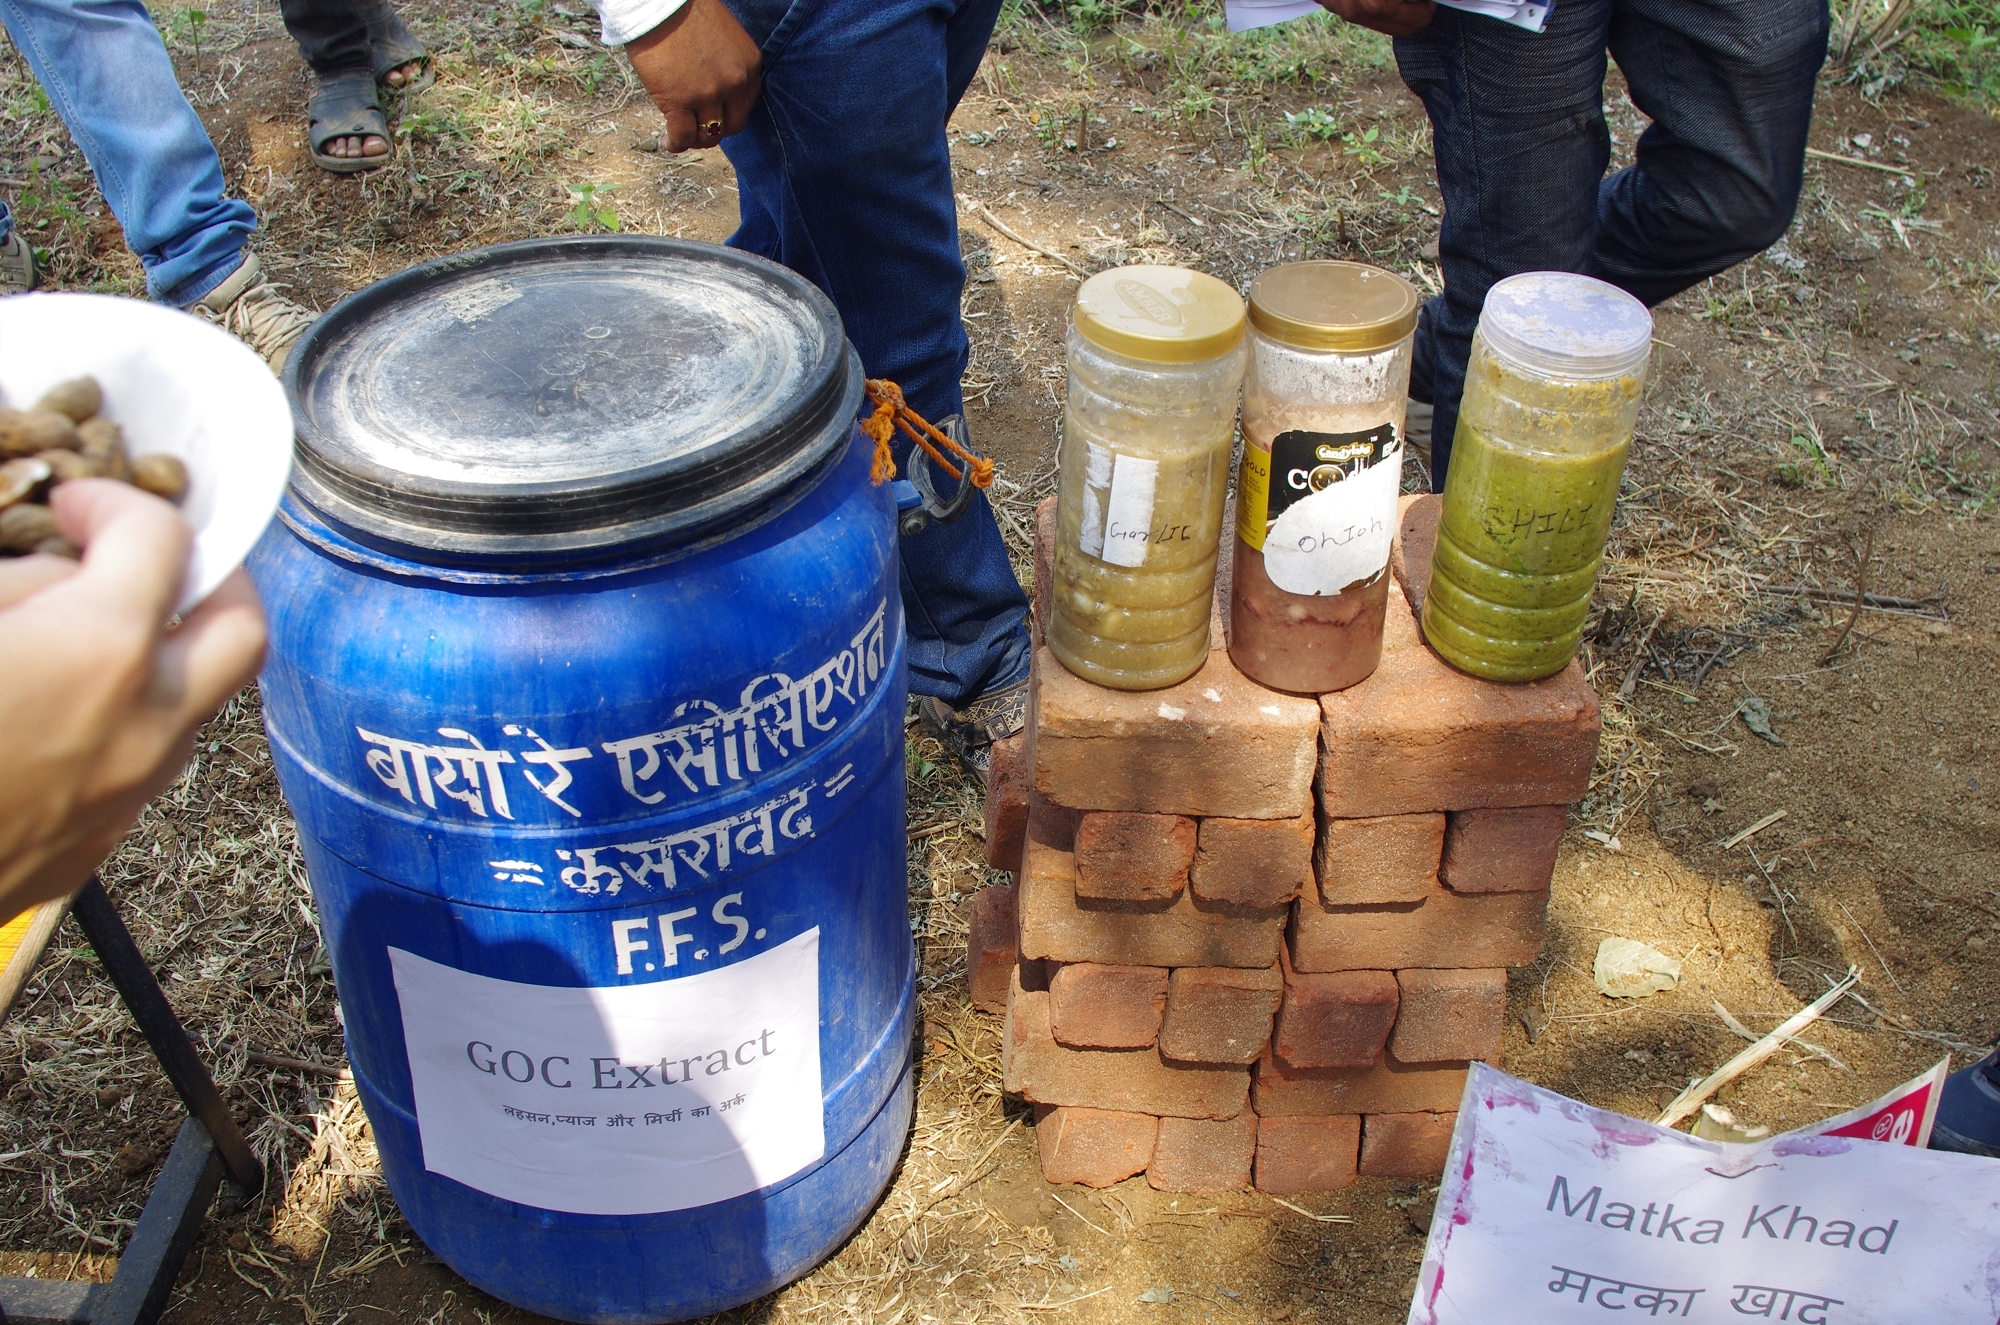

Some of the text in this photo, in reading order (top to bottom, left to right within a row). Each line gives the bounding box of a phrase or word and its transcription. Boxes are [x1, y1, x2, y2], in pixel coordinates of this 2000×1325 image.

[1480, 504, 1593, 539] CHILI
[356, 725, 516, 820] बायो
[602, 597, 887, 805] एसोसिएशन
[611, 892, 767, 975] F.F.S.
[466, 1028, 777, 1090] GOC Extract
[606, 1113, 636, 1127] और
[643, 1108, 683, 1126] मिर्ची
[690, 1104, 711, 1118] का
[719, 1092, 747, 1112] अर्क
[1546, 1174, 1899, 1255] Matka Khad
[1547, 1264, 1845, 1325] मटका खाद
